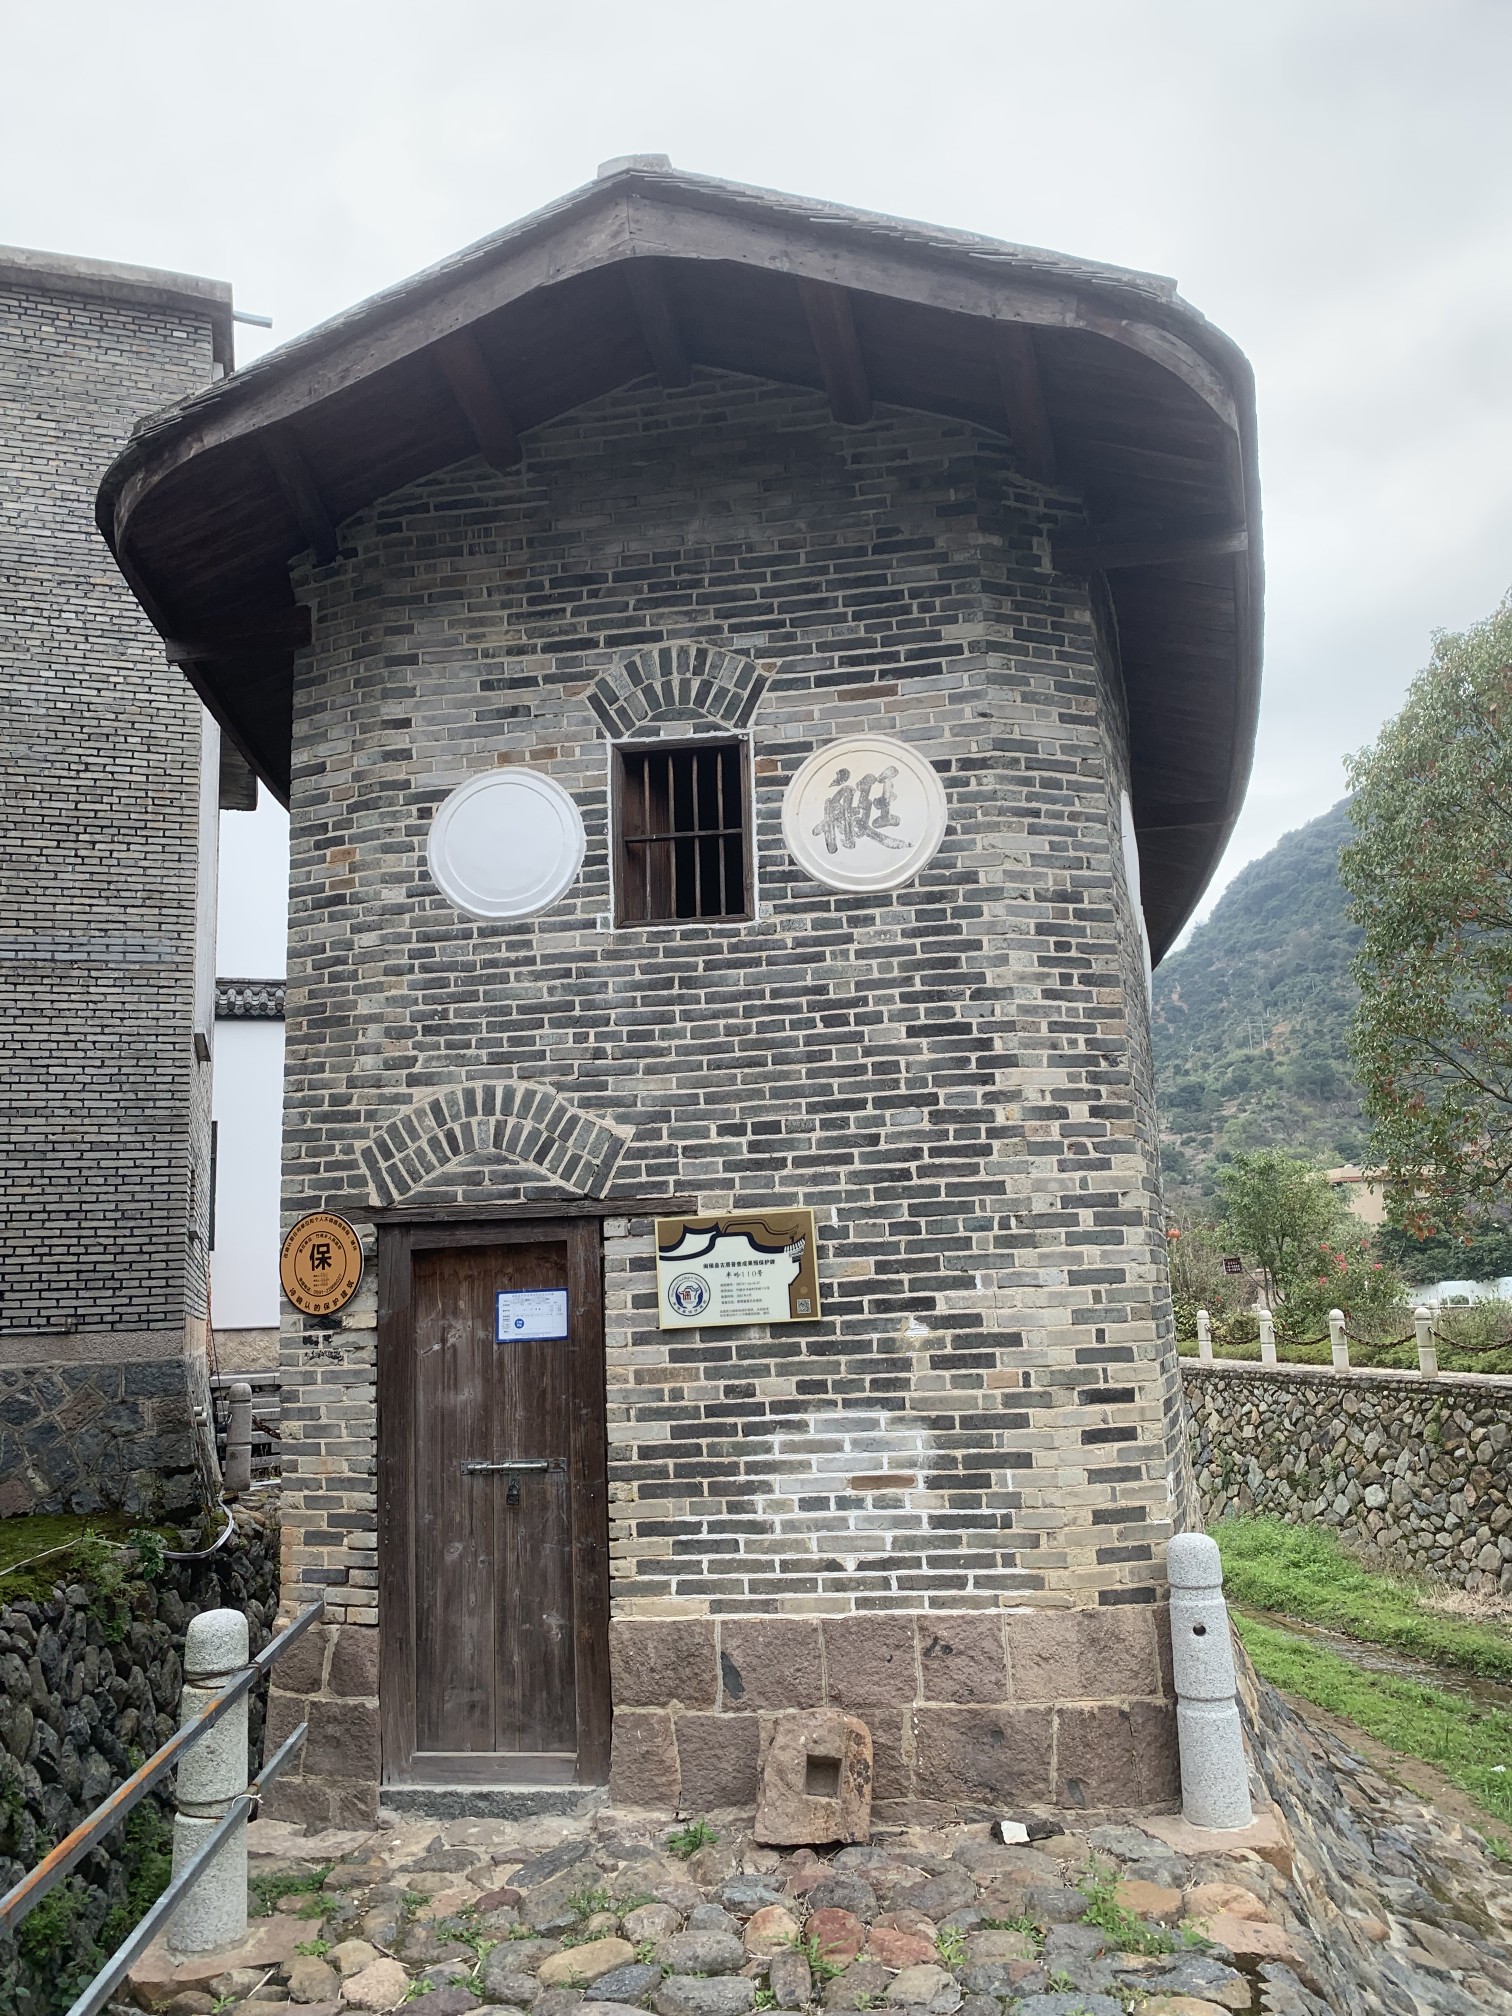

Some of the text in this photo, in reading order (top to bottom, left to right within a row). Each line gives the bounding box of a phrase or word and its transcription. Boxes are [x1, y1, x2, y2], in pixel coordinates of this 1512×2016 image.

[309, 1243, 332, 1271] 保
[288, 1279, 355, 1312] 待确认的保护建筑
